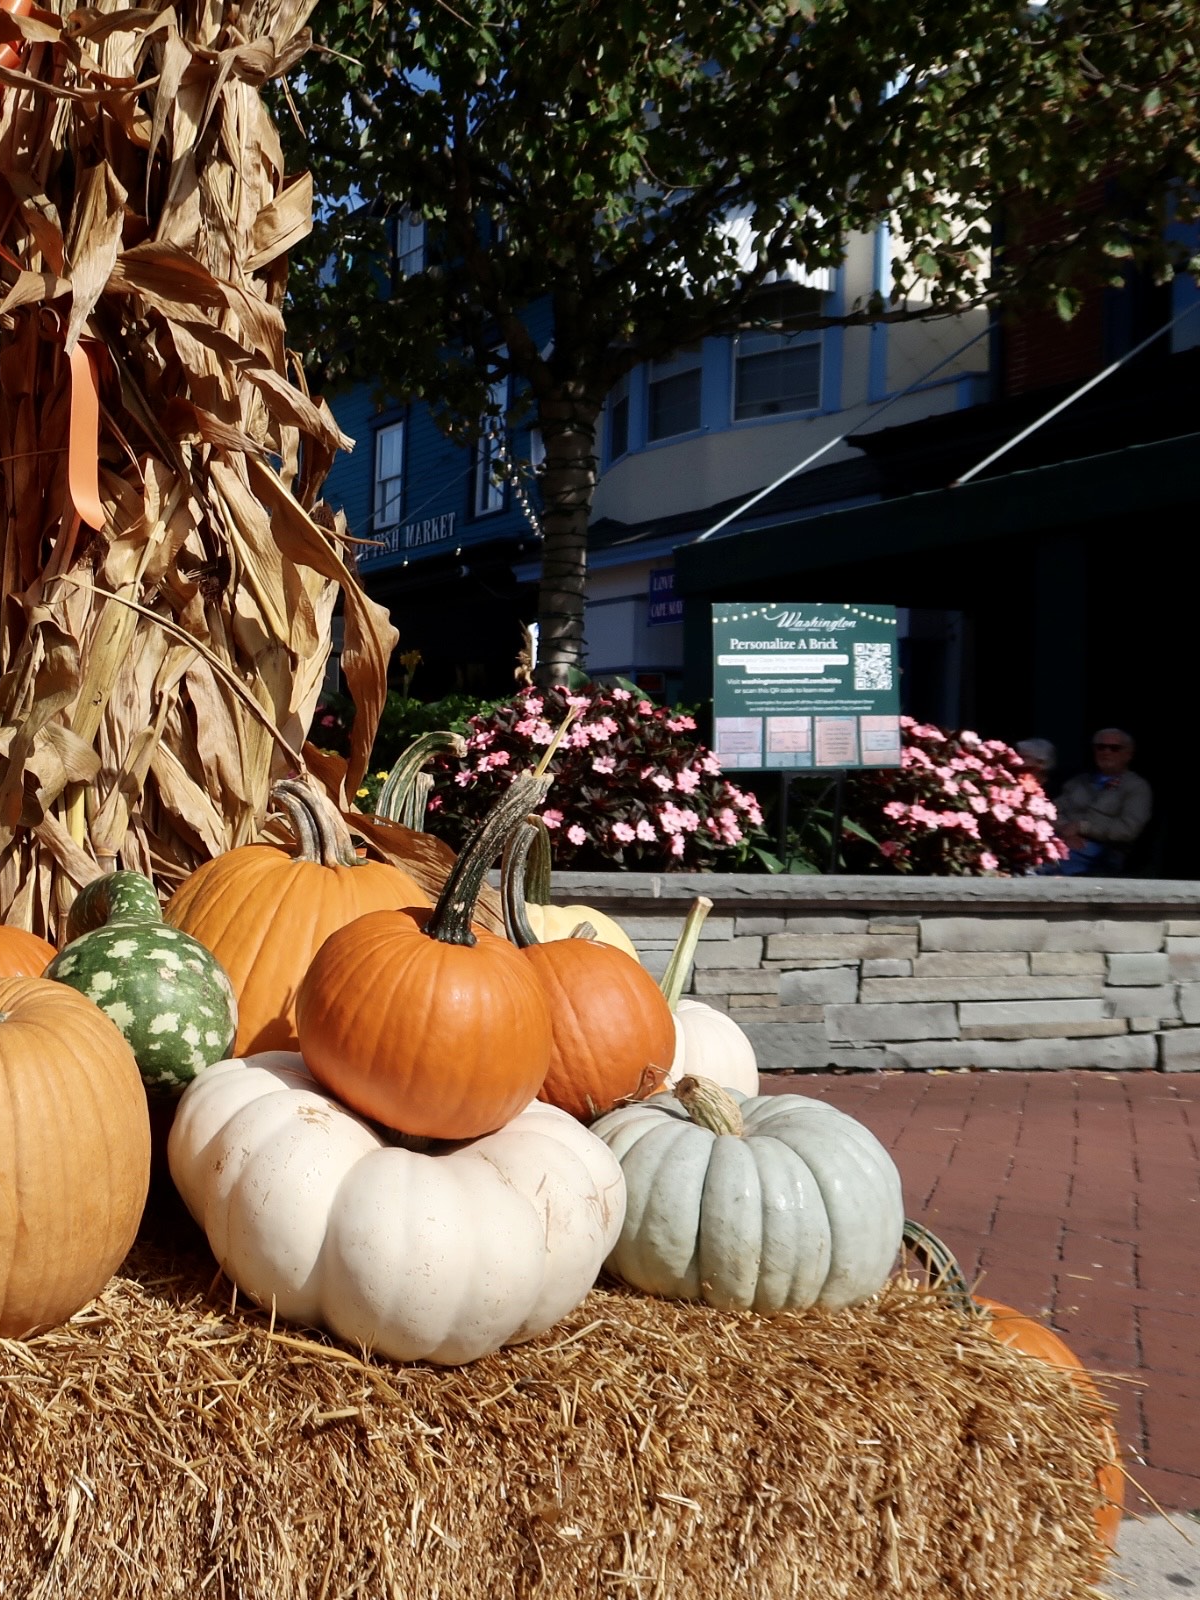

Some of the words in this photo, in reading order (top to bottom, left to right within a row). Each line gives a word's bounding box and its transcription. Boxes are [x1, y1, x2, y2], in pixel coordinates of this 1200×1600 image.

[405, 511, 456, 549] MARKET
[763, 610, 857, 632] Washington
[729, 637, 796, 650] Personalize
[798, 638, 807, 650] A
[809, 638, 838, 650] Brick
